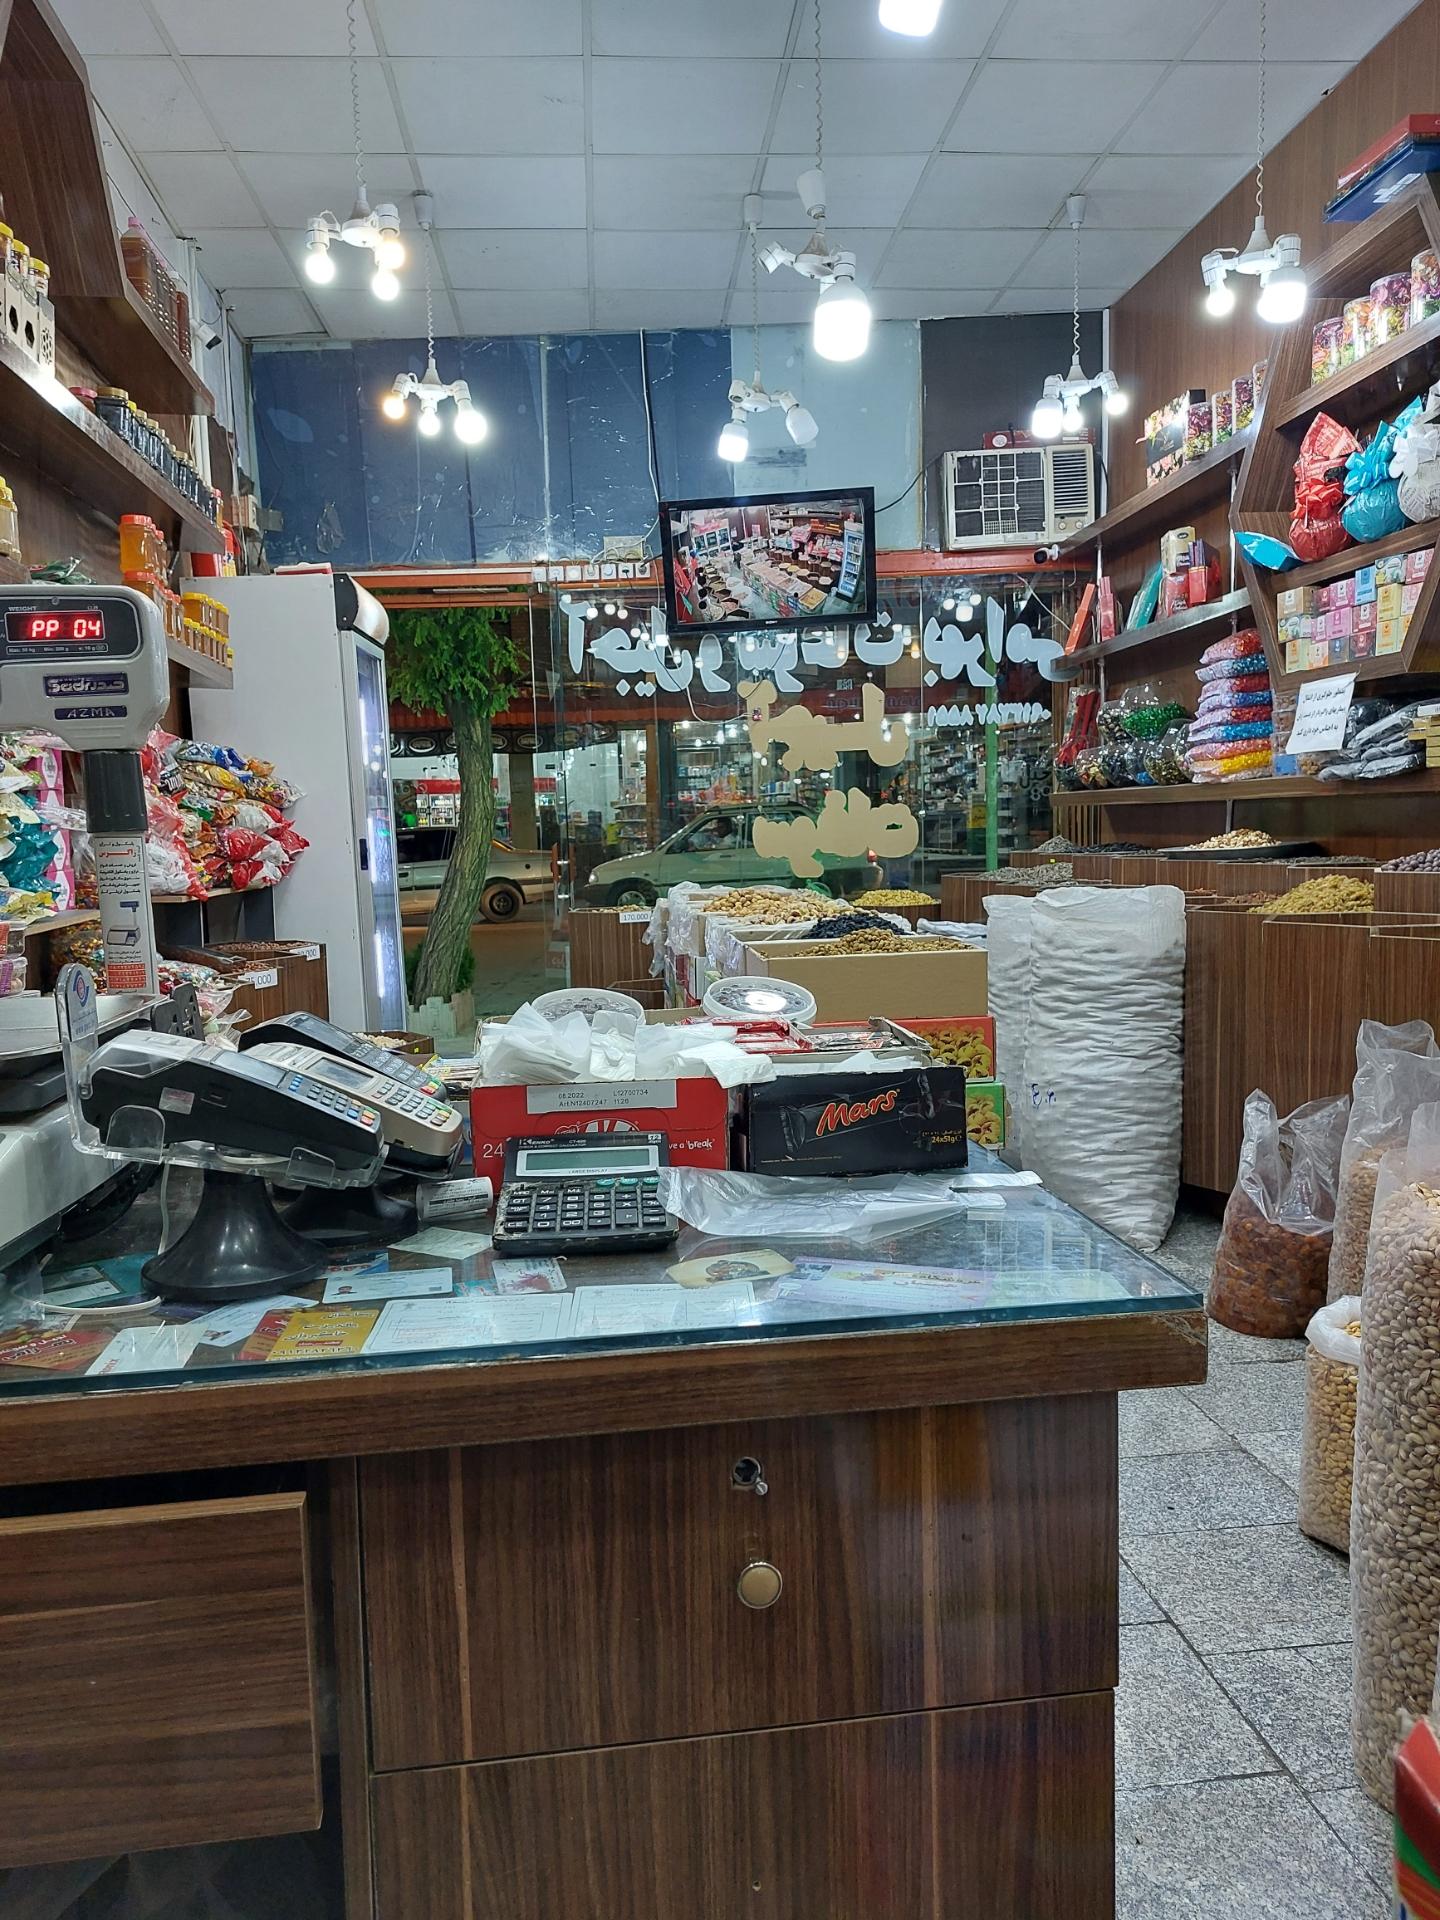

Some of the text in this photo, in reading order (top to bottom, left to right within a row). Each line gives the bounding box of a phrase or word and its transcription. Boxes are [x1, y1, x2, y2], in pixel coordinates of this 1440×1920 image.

[32, 619, 101, 638] PP 04
[67, 708, 115, 718] AZMA
[815, 1089, 898, 1137] Mars
